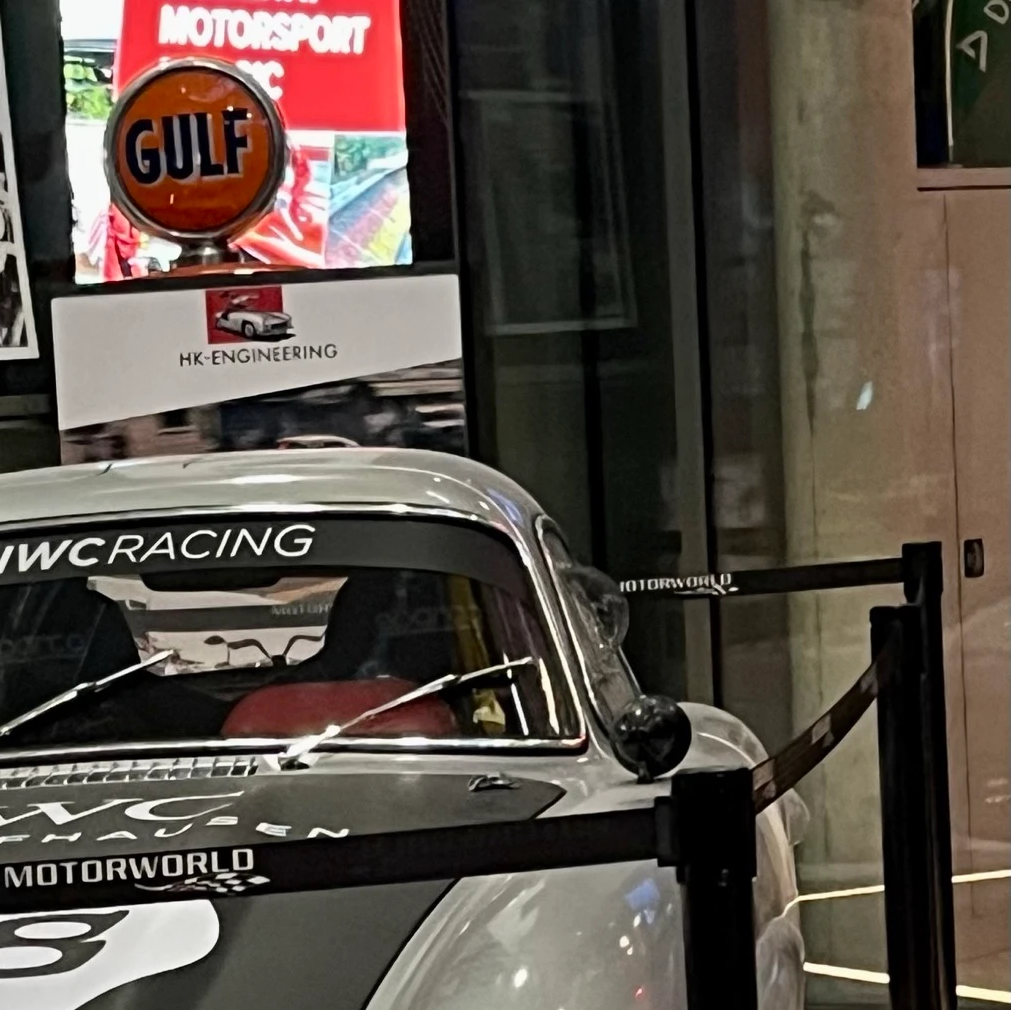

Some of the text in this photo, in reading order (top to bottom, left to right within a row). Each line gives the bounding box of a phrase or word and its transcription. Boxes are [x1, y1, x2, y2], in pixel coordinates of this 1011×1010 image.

[158, 4, 371, 54] MOTORSPORT
[125, 108, 253, 185] GULF
[179, 344, 338, 367] HK-ENGINEERING
[4, 848, 254, 888] MOTORWORLD
